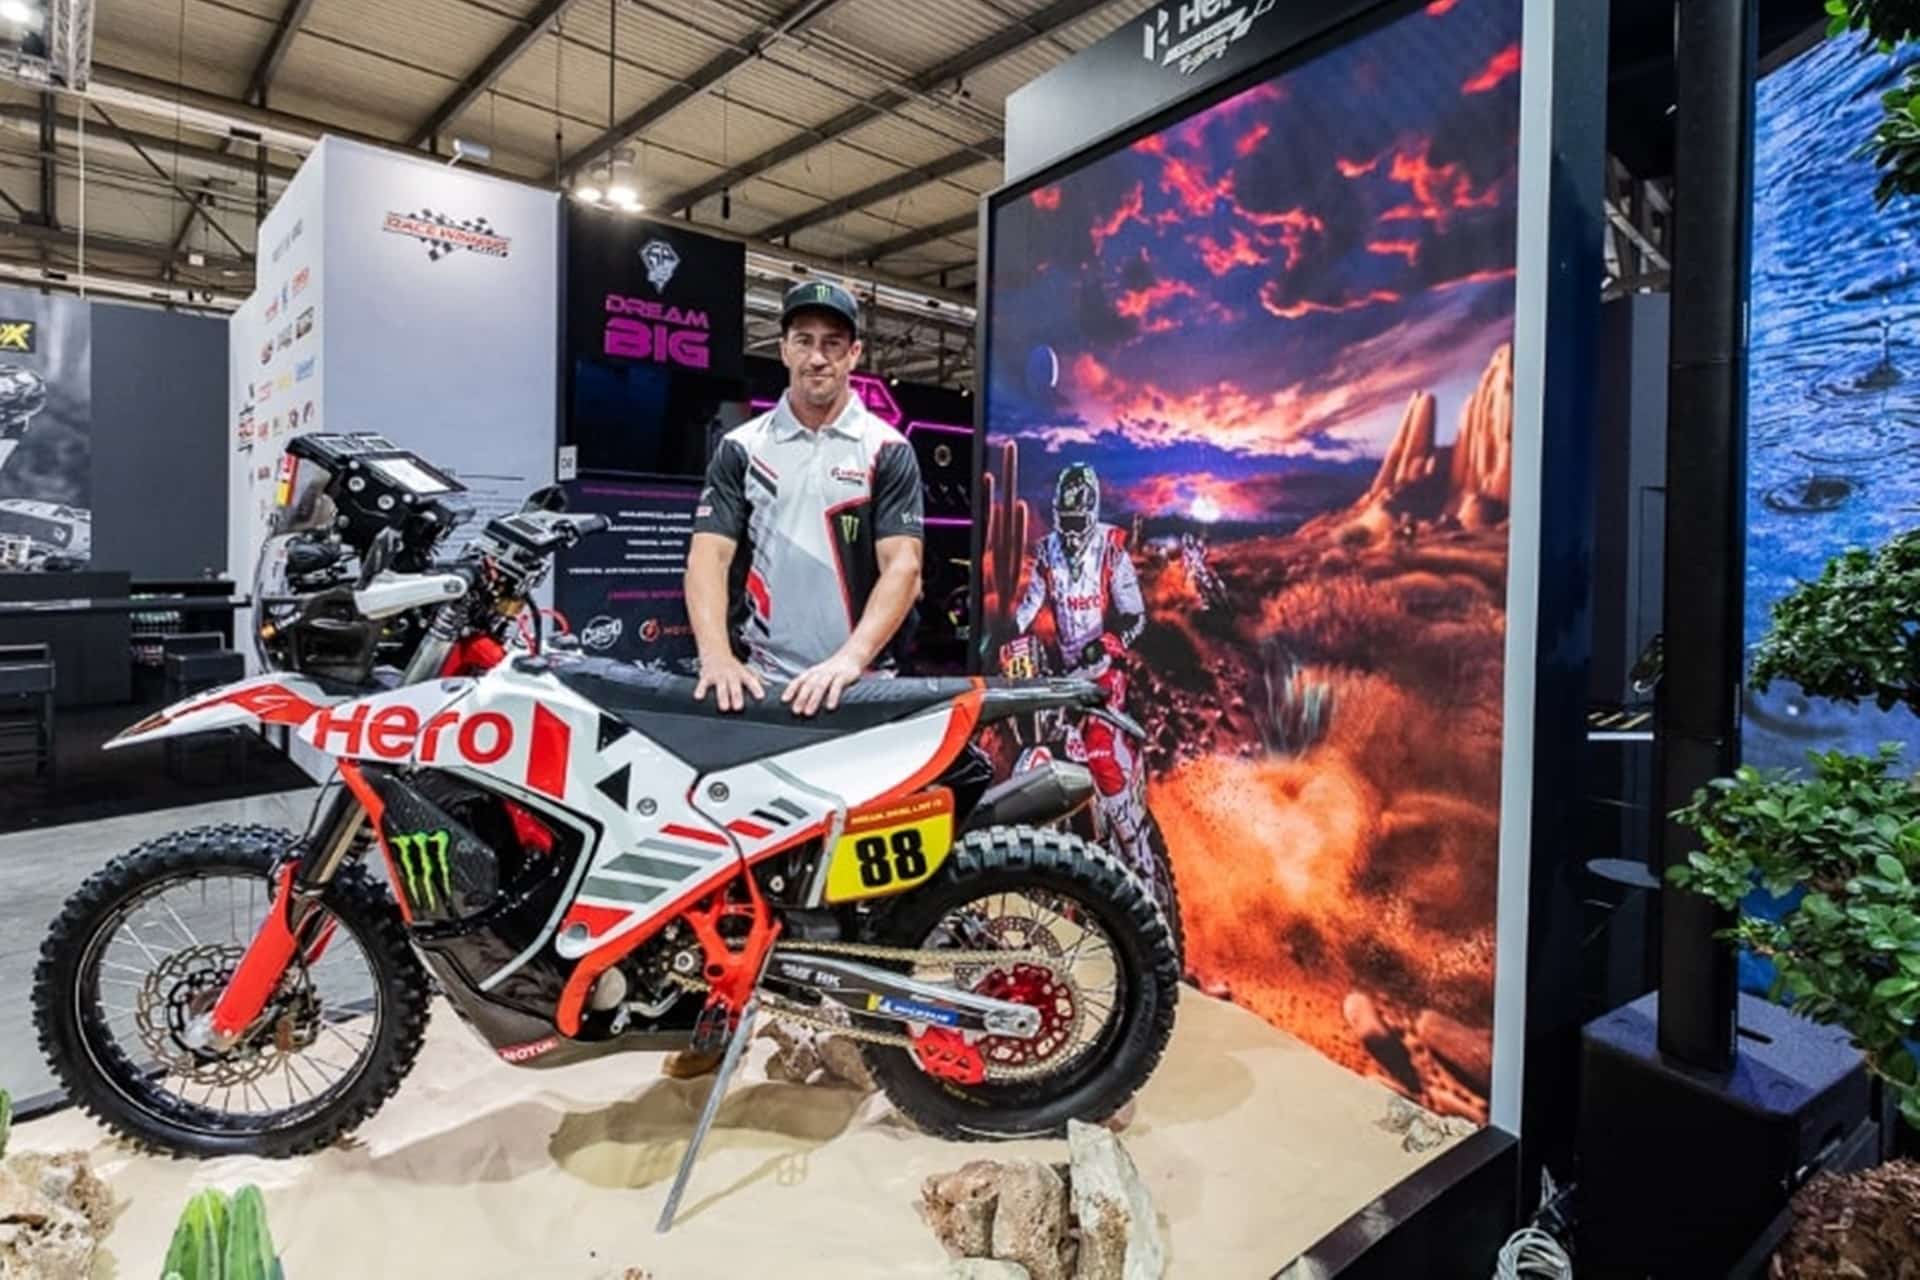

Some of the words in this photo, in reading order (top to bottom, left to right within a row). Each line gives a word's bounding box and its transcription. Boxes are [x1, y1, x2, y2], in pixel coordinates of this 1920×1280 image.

[605, 294, 709, 329] DREAM
[604, 318, 711, 368] BIG
[312, 703, 514, 765] Hero
[854, 828, 928, 888] 88
